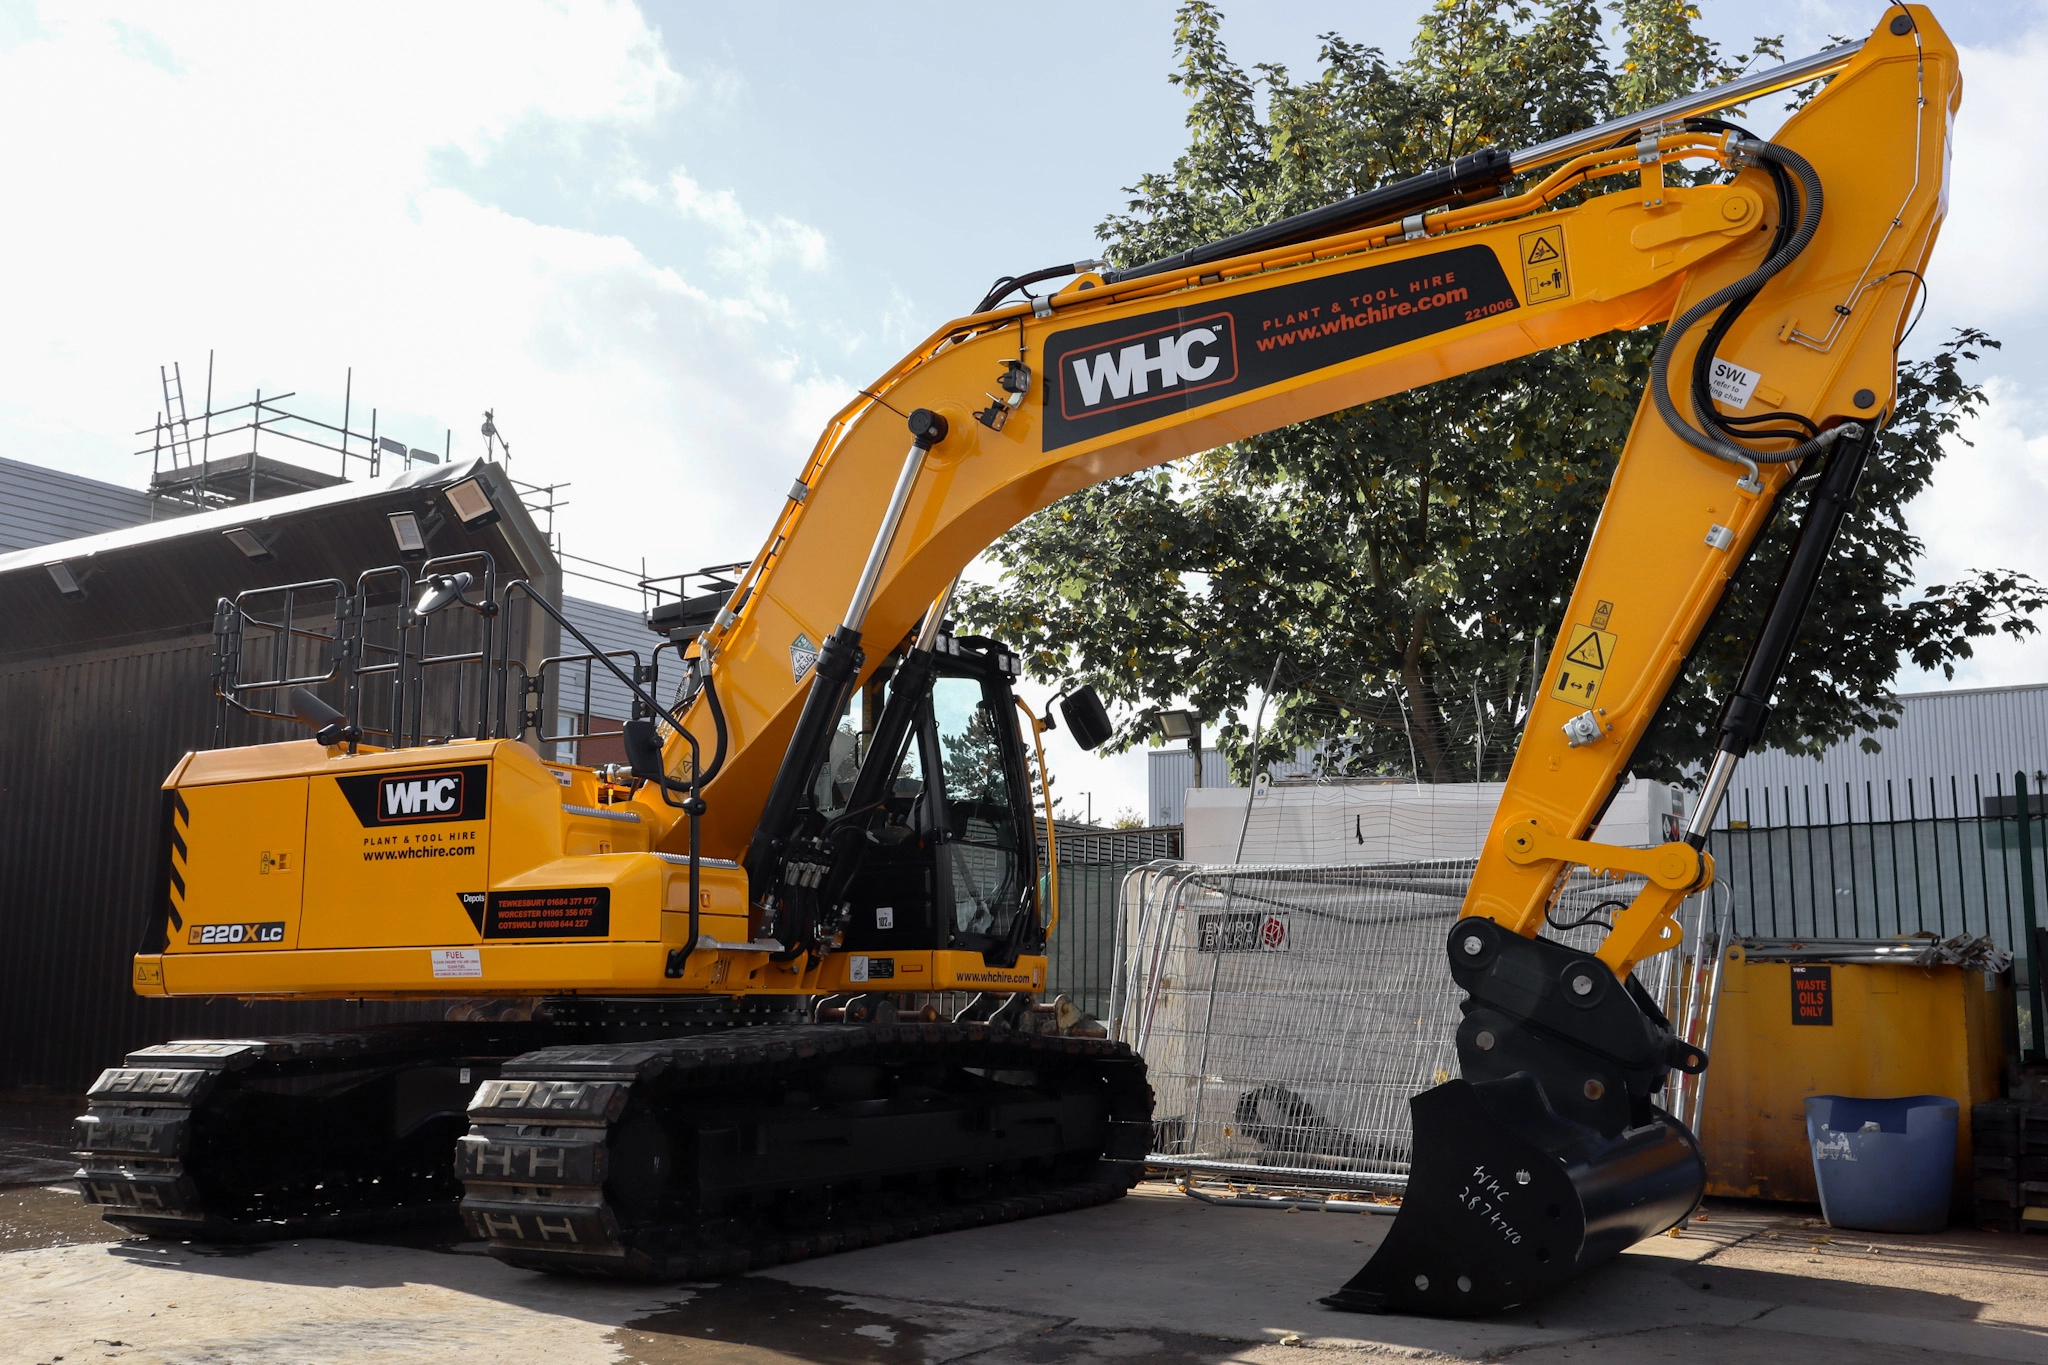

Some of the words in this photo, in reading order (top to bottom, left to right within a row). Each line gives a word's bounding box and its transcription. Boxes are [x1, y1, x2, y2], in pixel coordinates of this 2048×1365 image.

[1262, 307, 1320, 331] PLANT
[1331, 302, 1341, 313] &
[1350, 287, 1399, 308] TOOL
[1409, 271, 1456, 293] HIRE
[1464, 298, 1514, 321] 221006
[1256, 287, 1468, 352] www.whchire.com
[1072, 328, 1220, 407] WHC
[1715, 364, 1747, 387] SWL
[1713, 379, 1731, 390] refer
[1724, 393, 1743, 405] chart
[385, 778, 456, 815] WHC
[363, 836, 398, 846] PLANT
[403, 835, 410, 844] &
[415, 833, 443, 843] TOOL
[449, 831, 476, 841] HIRE
[363, 845, 475, 861] www.whchire.com
[463, 893, 485, 905] Depots
[498, 898, 546, 908] TEWKESBURY
[547, 898, 568, 906] 01684
[569, 897, 583, 906] 377
[583, 897, 597, 905] 977
[498, 910, 541, 919] WORCESTER
[542, 909, 563, 918] 01905
[564, 909, 578, 917] 356
[579, 908, 593, 916] 075
[498, 921, 537, 930] COTSWOLD
[560, 920, 574, 928] 644
[574, 919, 589, 928] 227
[260, 927, 283, 942] LC
[445, 951, 465, 959] FUEL
[956, 970, 1030, 984] www.whchire.com
[1796, 980, 1827, 991] WASTE
[1799, 991, 1824, 1005] OILS
[1800, 1006, 1824, 1017] ONLY
